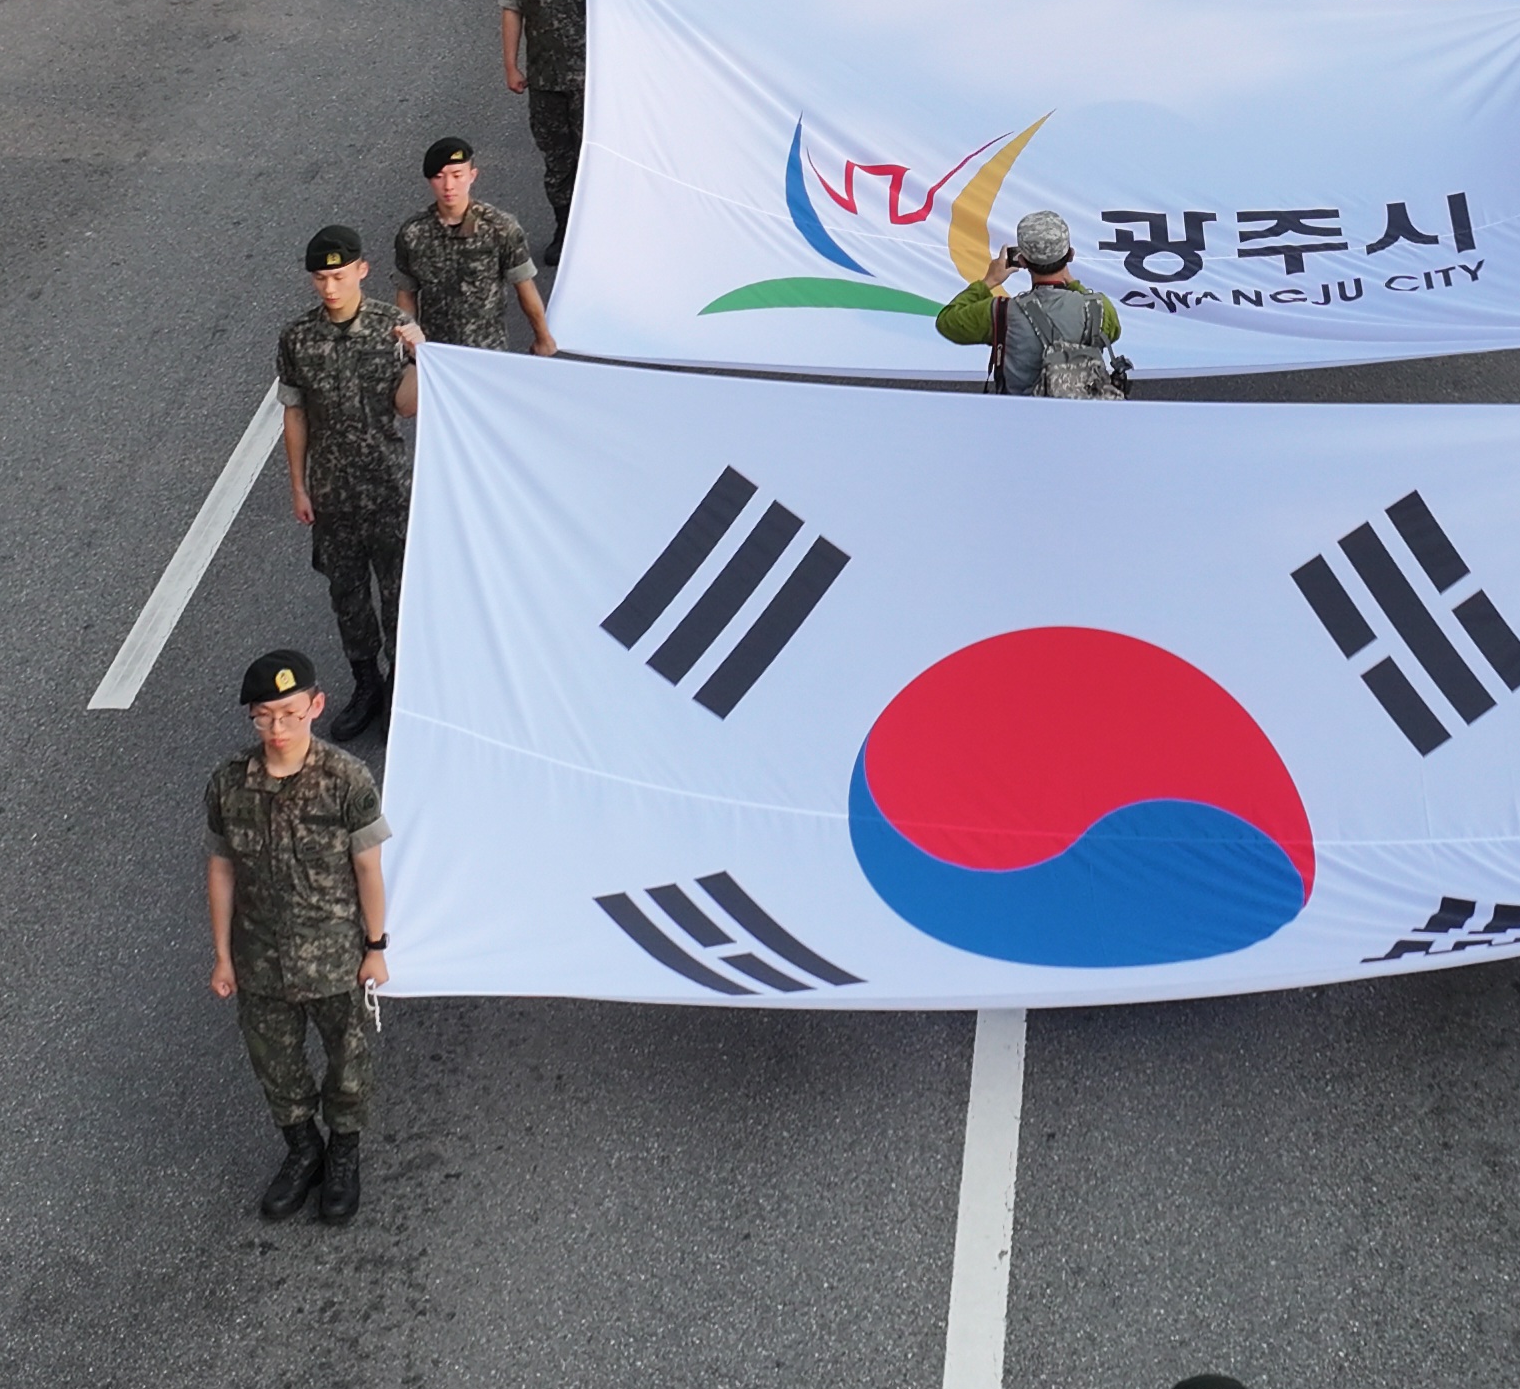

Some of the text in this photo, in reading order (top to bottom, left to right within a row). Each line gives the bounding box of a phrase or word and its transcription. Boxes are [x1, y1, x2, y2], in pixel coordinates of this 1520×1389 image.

[1098, 191, 1477, 284] 광주시
[1119, 258, 1486, 314] GWANGJU CITY
